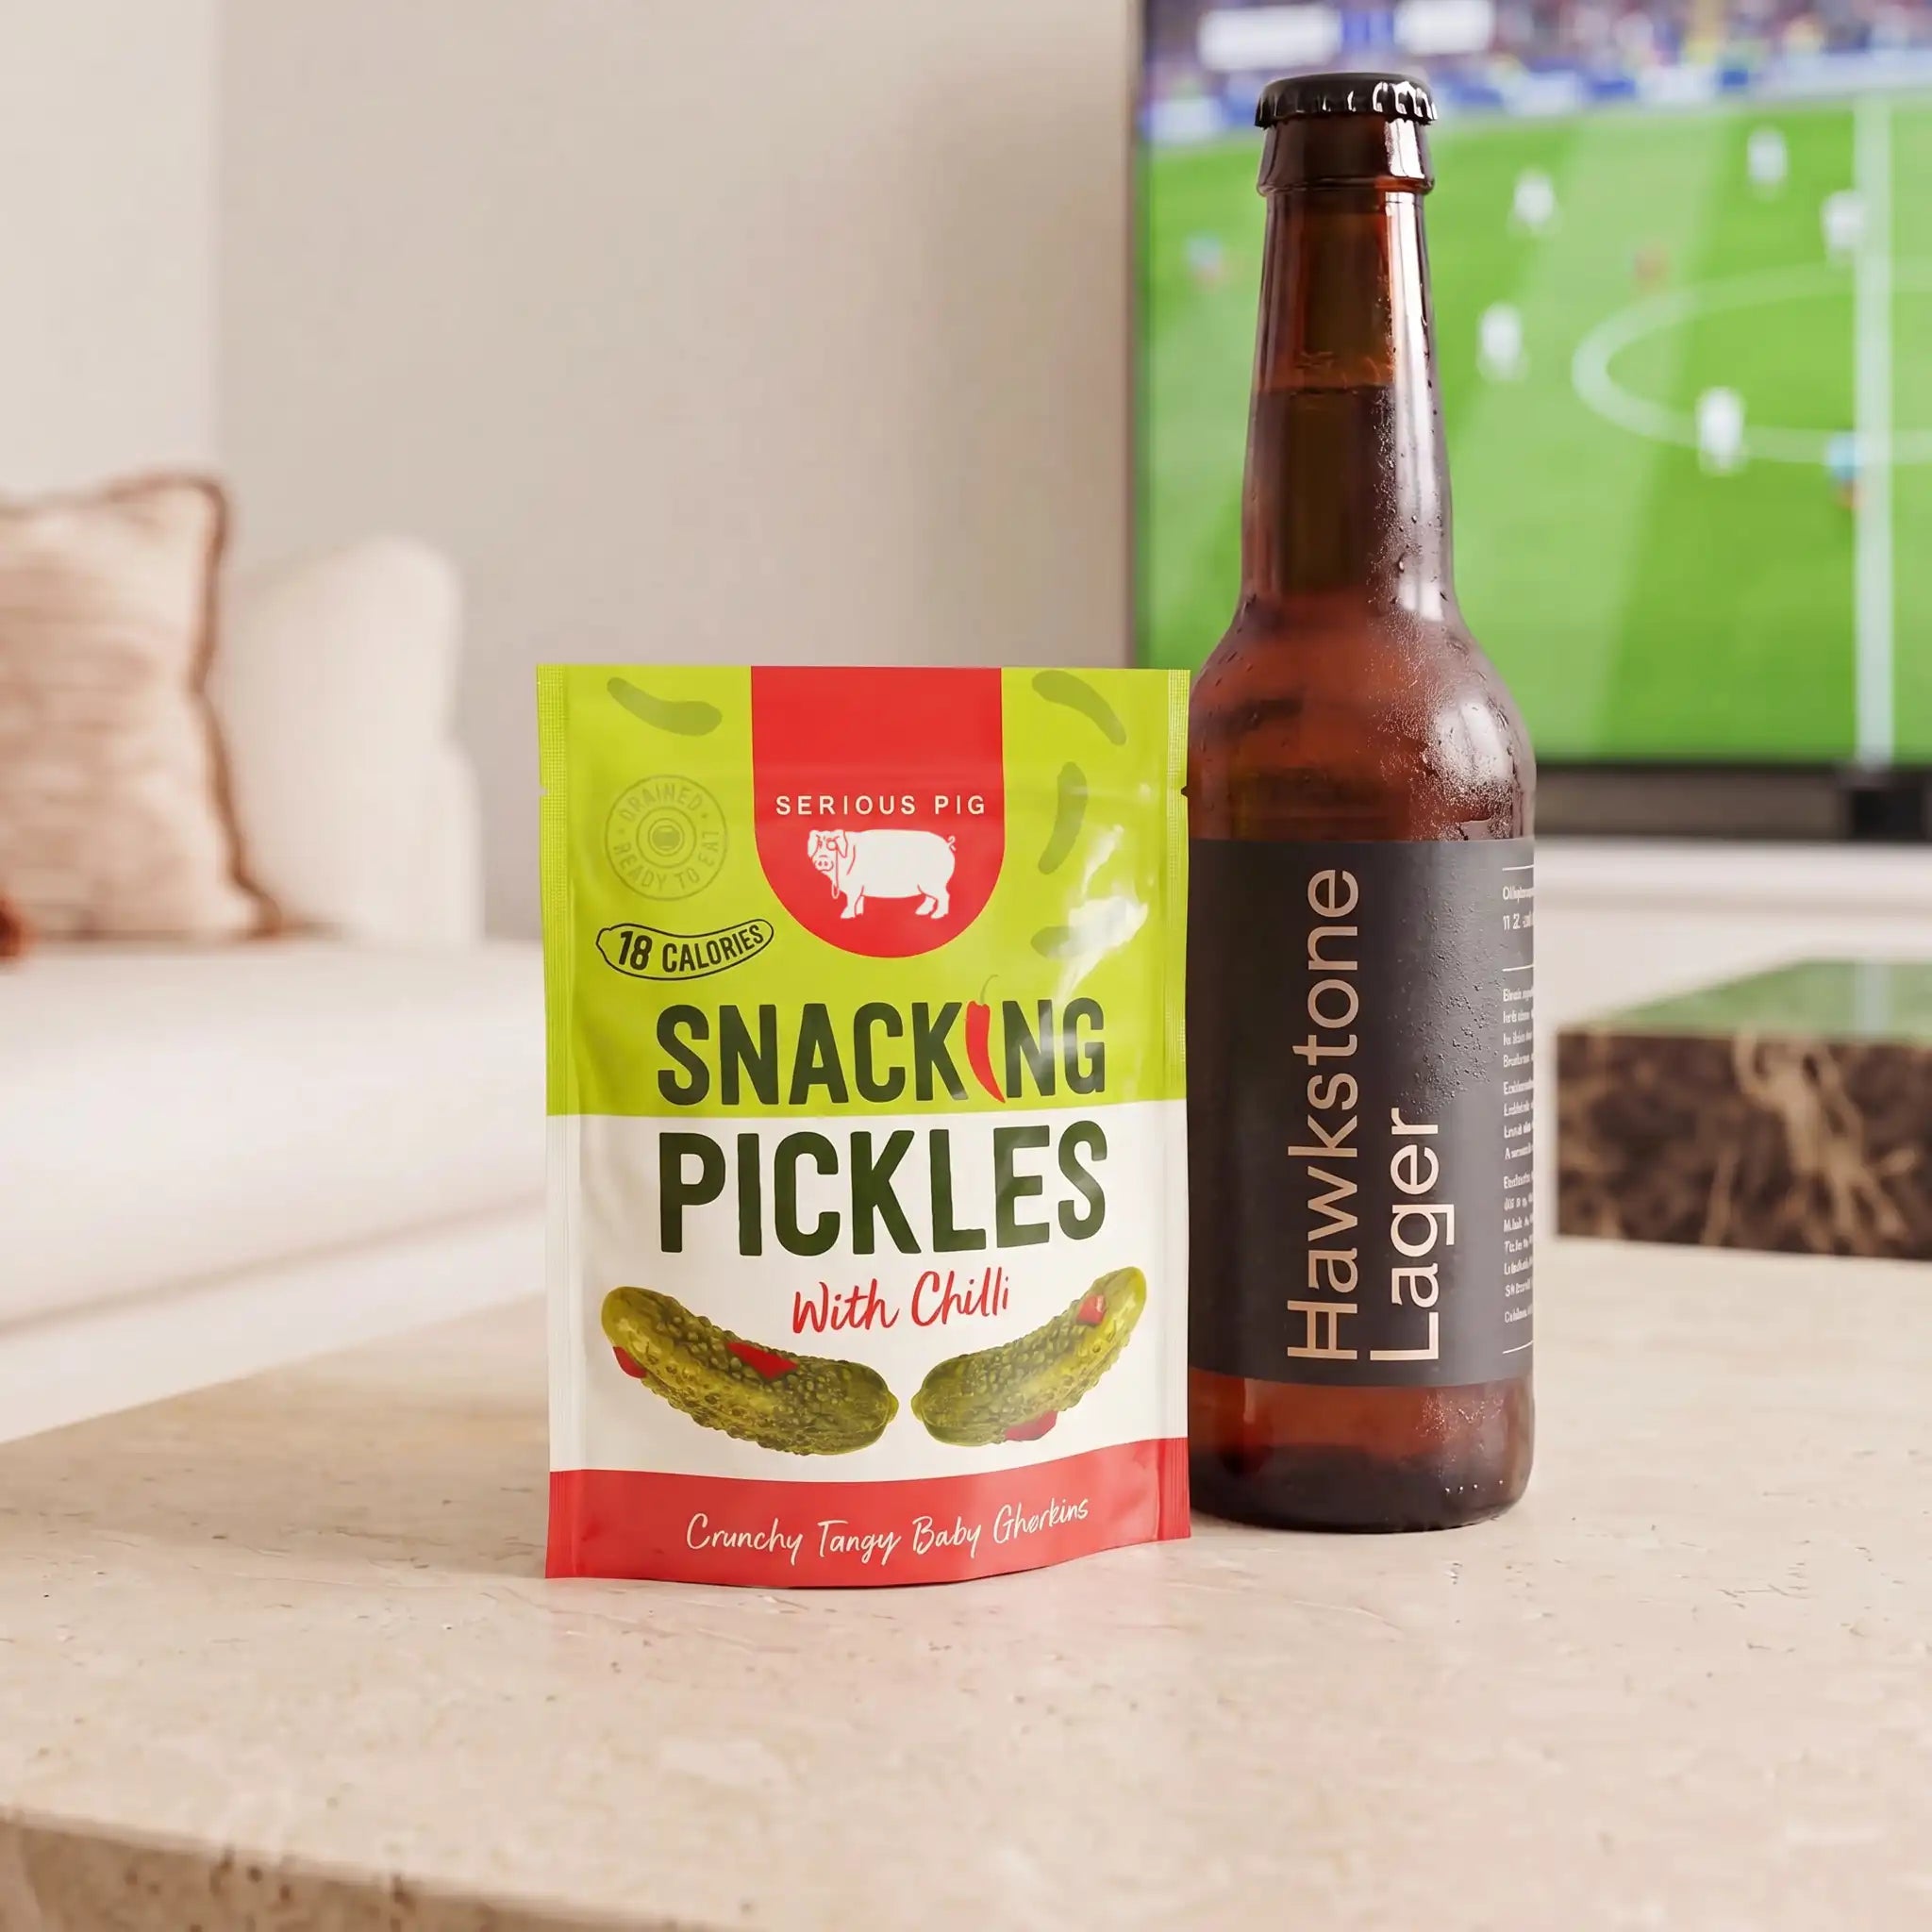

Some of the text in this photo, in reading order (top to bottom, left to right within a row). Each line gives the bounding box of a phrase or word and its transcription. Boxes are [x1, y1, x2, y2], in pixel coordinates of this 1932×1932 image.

[619, 782, 703, 823] DRAINED
[775, 795, 985, 815] SERIOUS PIG
[613, 830, 719, 891] READY TO EAT
[618, 924, 764, 973] 18 CALORIES
[656, 996, 1106, 1106] SNACKING
[1287, 869, 1358, 1360] Hawkstone
[659, 1120, 1108, 1256] PICKLES
[1370, 1108, 1455, 1360] Lager
[792, 1267, 1008, 1333] With Chilli
[687, 1498, 1090, 1565] Crunchy Tangy Baby Gherkins
